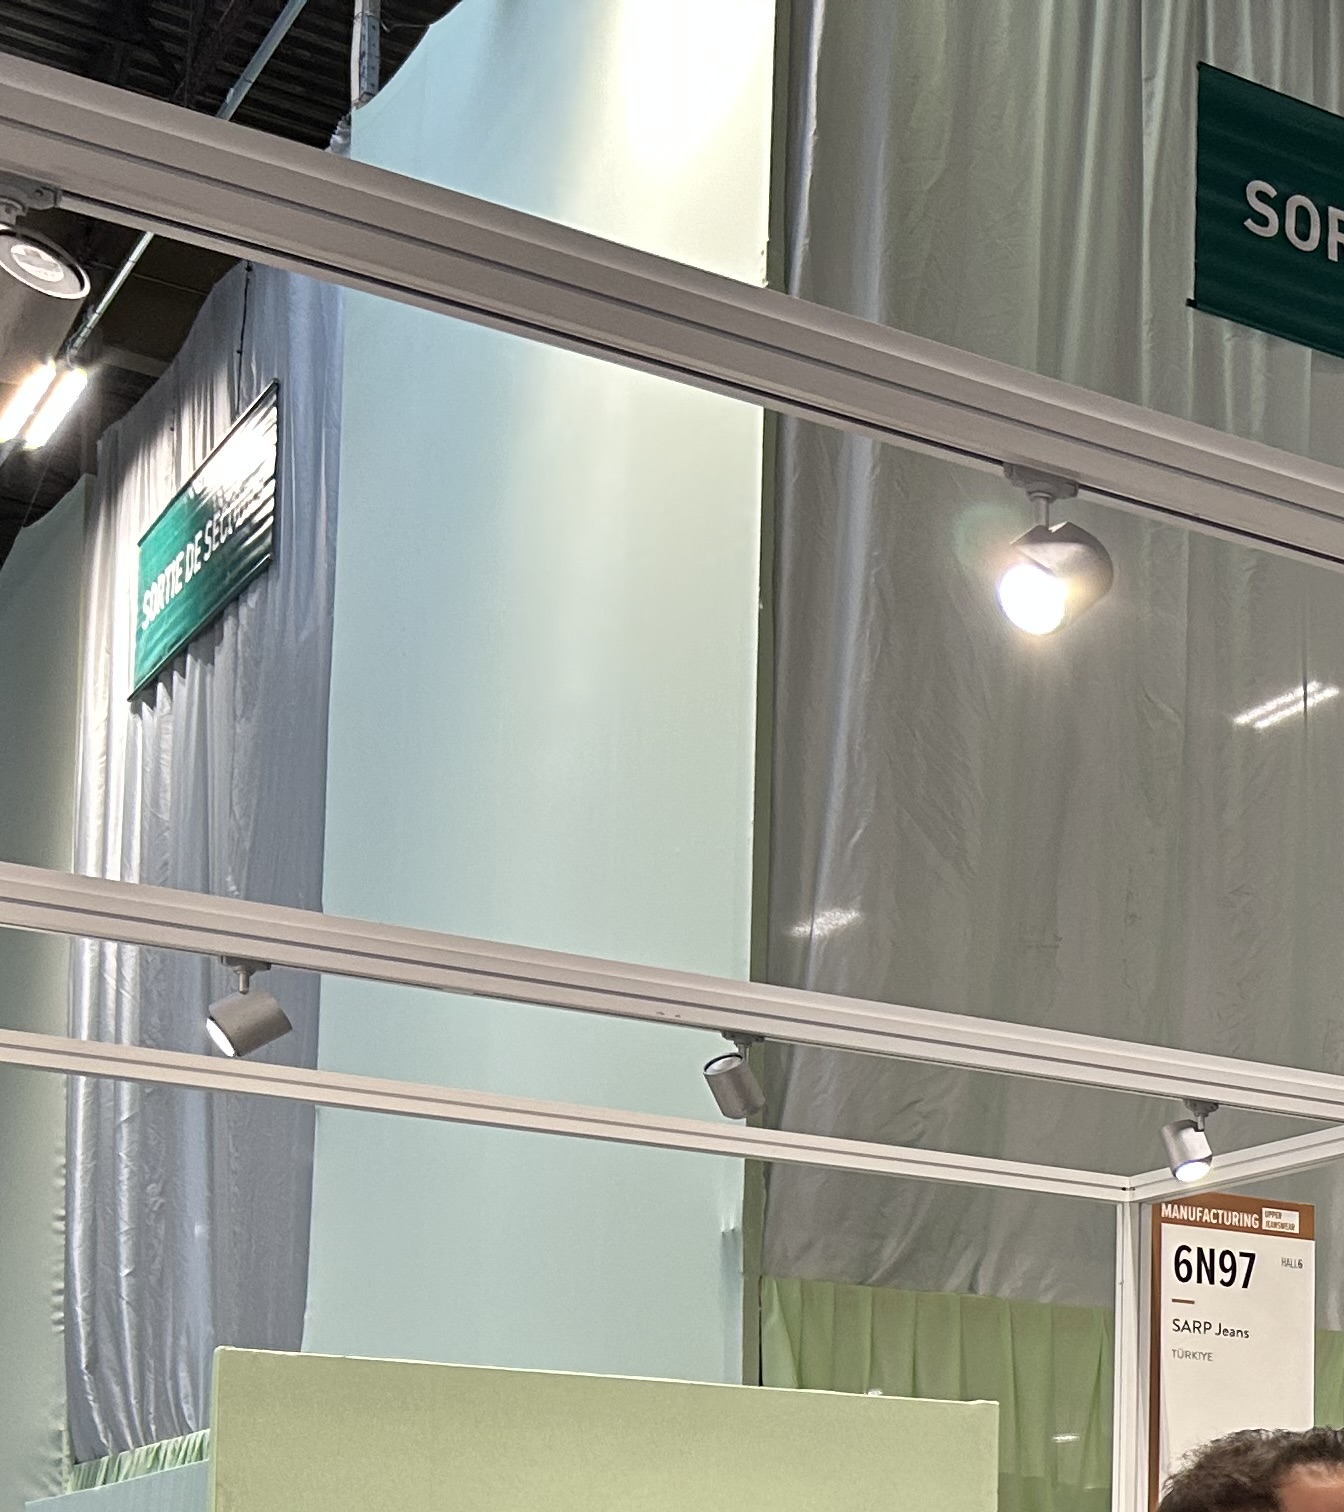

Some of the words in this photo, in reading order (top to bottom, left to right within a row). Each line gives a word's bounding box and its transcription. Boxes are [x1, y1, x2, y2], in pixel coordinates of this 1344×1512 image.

[142, 550, 185, 631] SORTIE
[185, 530, 203, 583] DE
[1161, 1203, 1260, 1229] MANUFACTURING
[1265, 1210, 1282, 1219] UPPER
[1174, 1244, 1257, 1289] 6N97
[1172, 1318, 1212, 1335] SARP
[1215, 1322, 1250, 1339] Jeans
